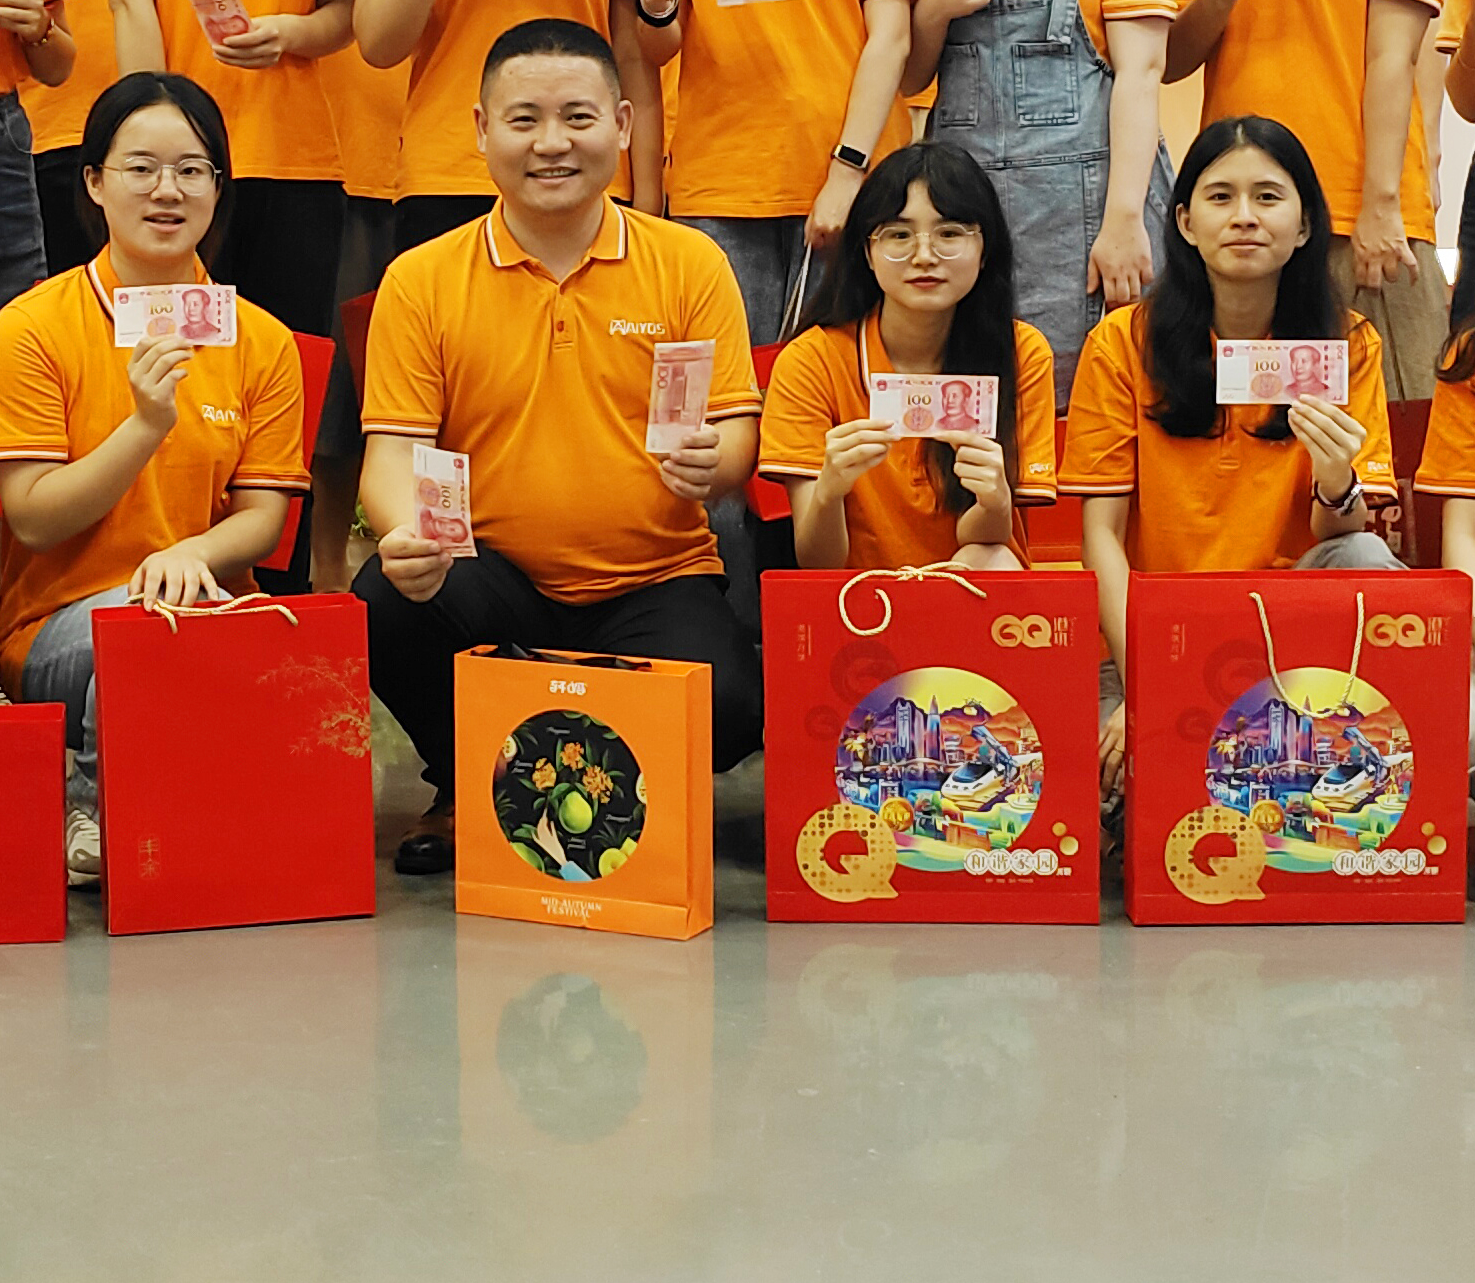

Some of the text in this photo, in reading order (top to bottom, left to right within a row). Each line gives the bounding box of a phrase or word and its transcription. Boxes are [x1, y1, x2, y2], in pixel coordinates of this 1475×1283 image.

[149, 304, 173, 314] 100
[626, 322, 665, 335] AIYOS
[1254, 360, 1280, 372] 100
[907, 395, 932, 405] 100
[440, 485, 452, 509] 100
[991, 614, 1052, 648] GQ
[1365, 613, 1426, 648] GQ
[969, 852, 1055, 872] 和谐家园
[1337, 852, 1423, 872] 和谐家园
[541, 896, 602, 911] MID-AUTUMN
[546, 904, 591, 919] FESTIVAL
